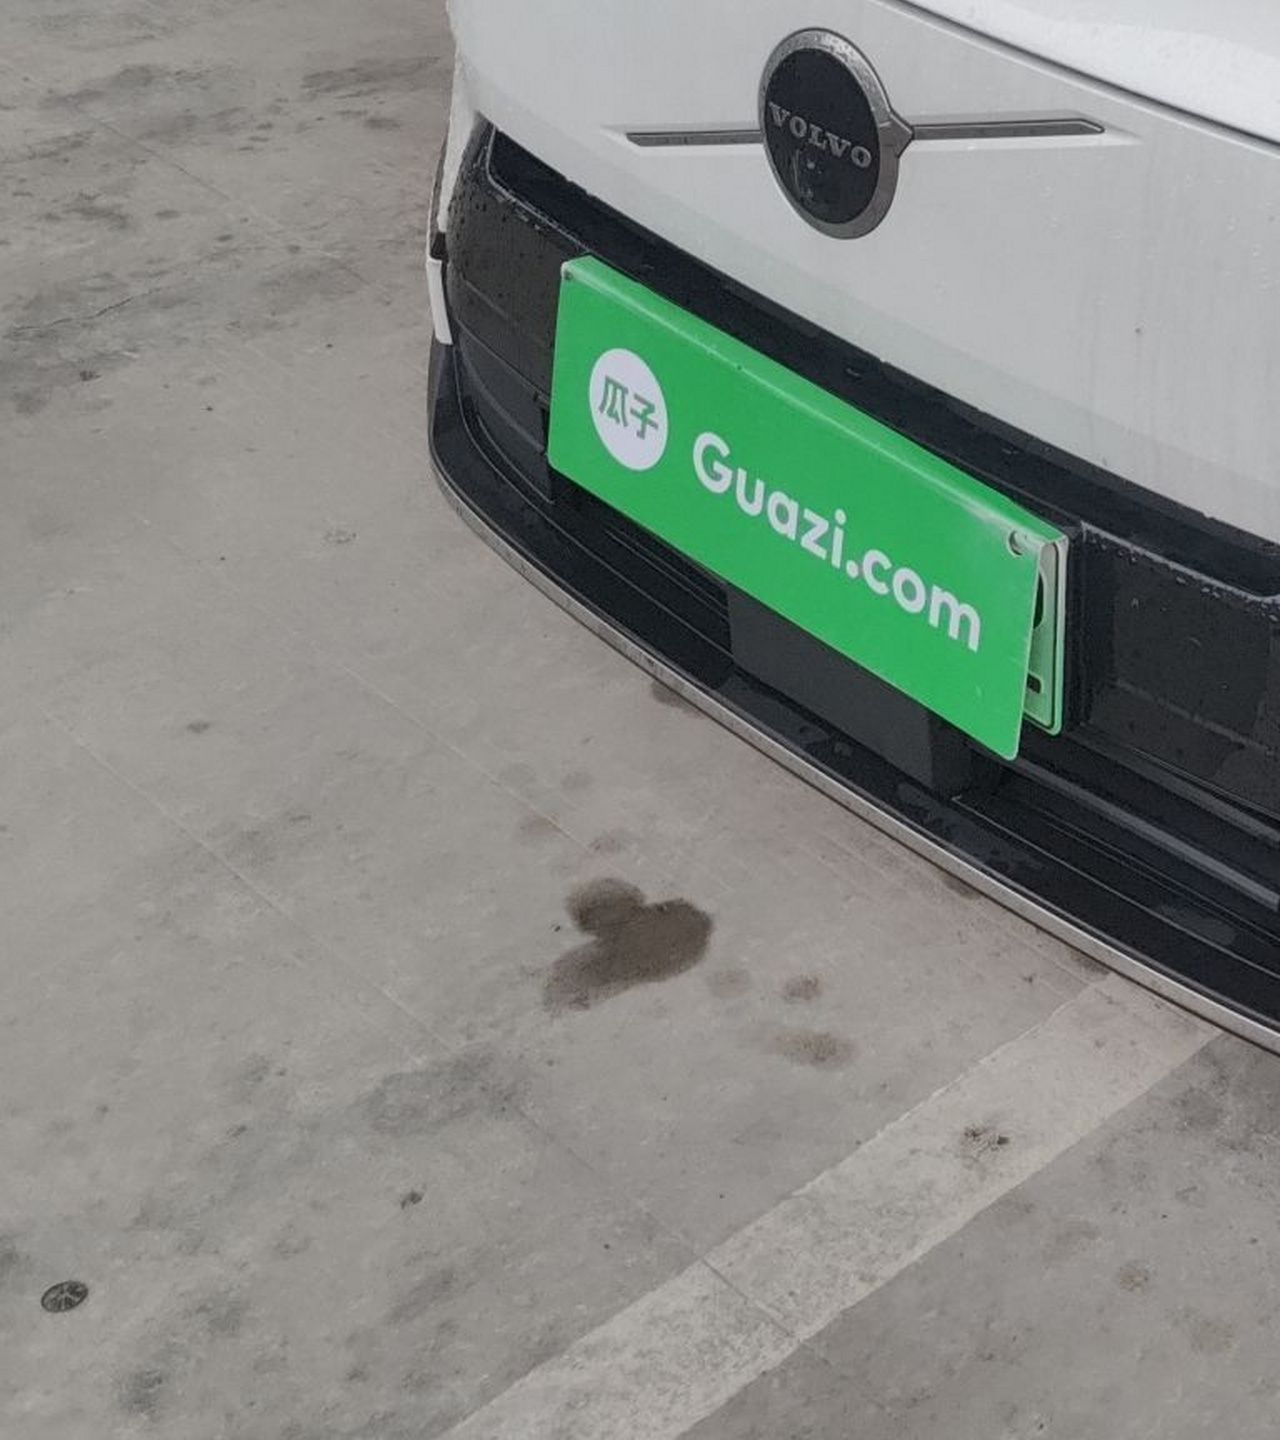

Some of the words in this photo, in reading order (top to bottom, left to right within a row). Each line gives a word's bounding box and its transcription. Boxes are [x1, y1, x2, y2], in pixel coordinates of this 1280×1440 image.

[768, 101, 872, 168] VOLVO
[598, 377, 660, 440] 瓜子
[692, 431, 982, 653] Guazi.com
